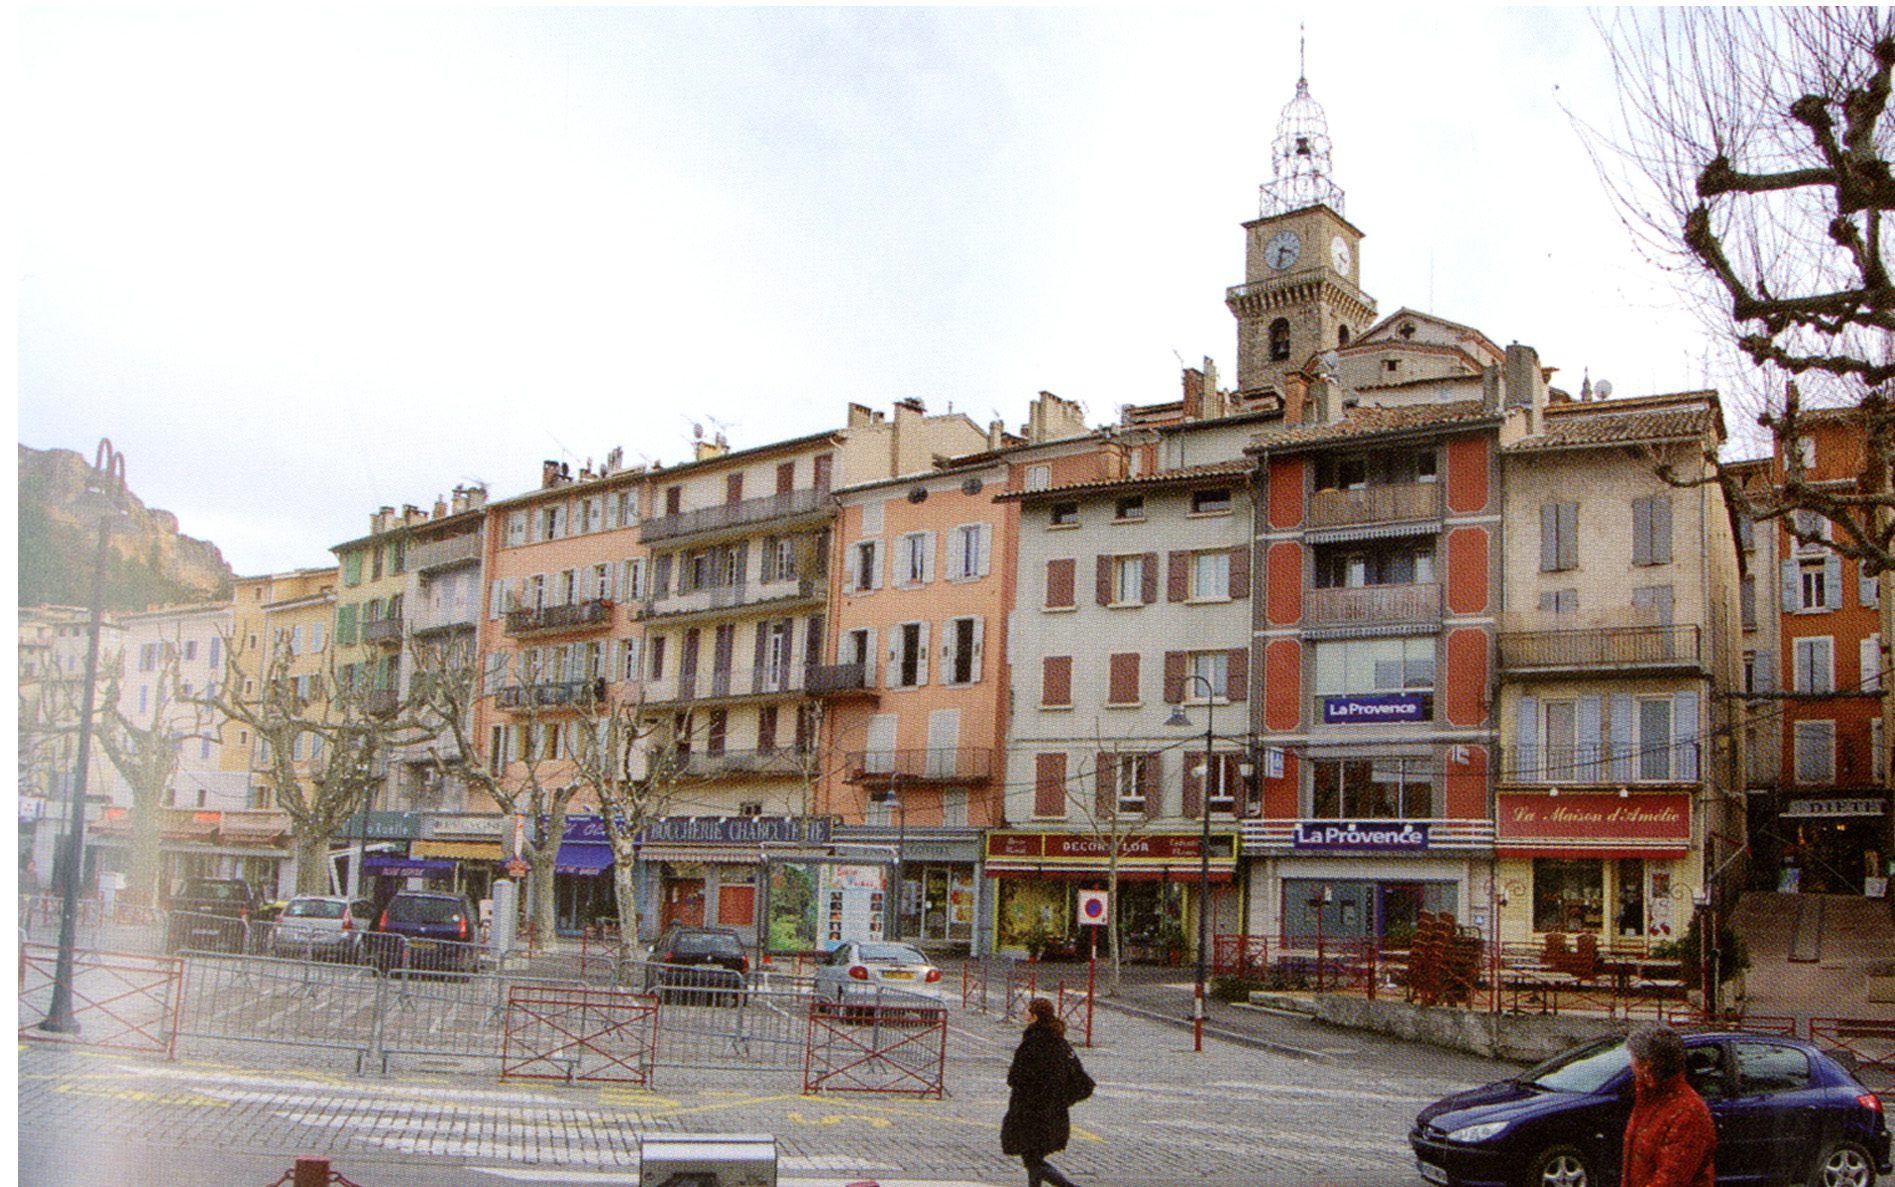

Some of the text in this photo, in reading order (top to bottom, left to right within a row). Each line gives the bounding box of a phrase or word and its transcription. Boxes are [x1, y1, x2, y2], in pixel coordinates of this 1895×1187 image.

[1330, 702, 1417, 716] La Provence
[1514, 806, 1536, 823] La
[1543, 805, 1603, 823] Maison
[652, 821, 722, 841] BOUCHERIE
[1298, 825, 1423, 844] La Provence
